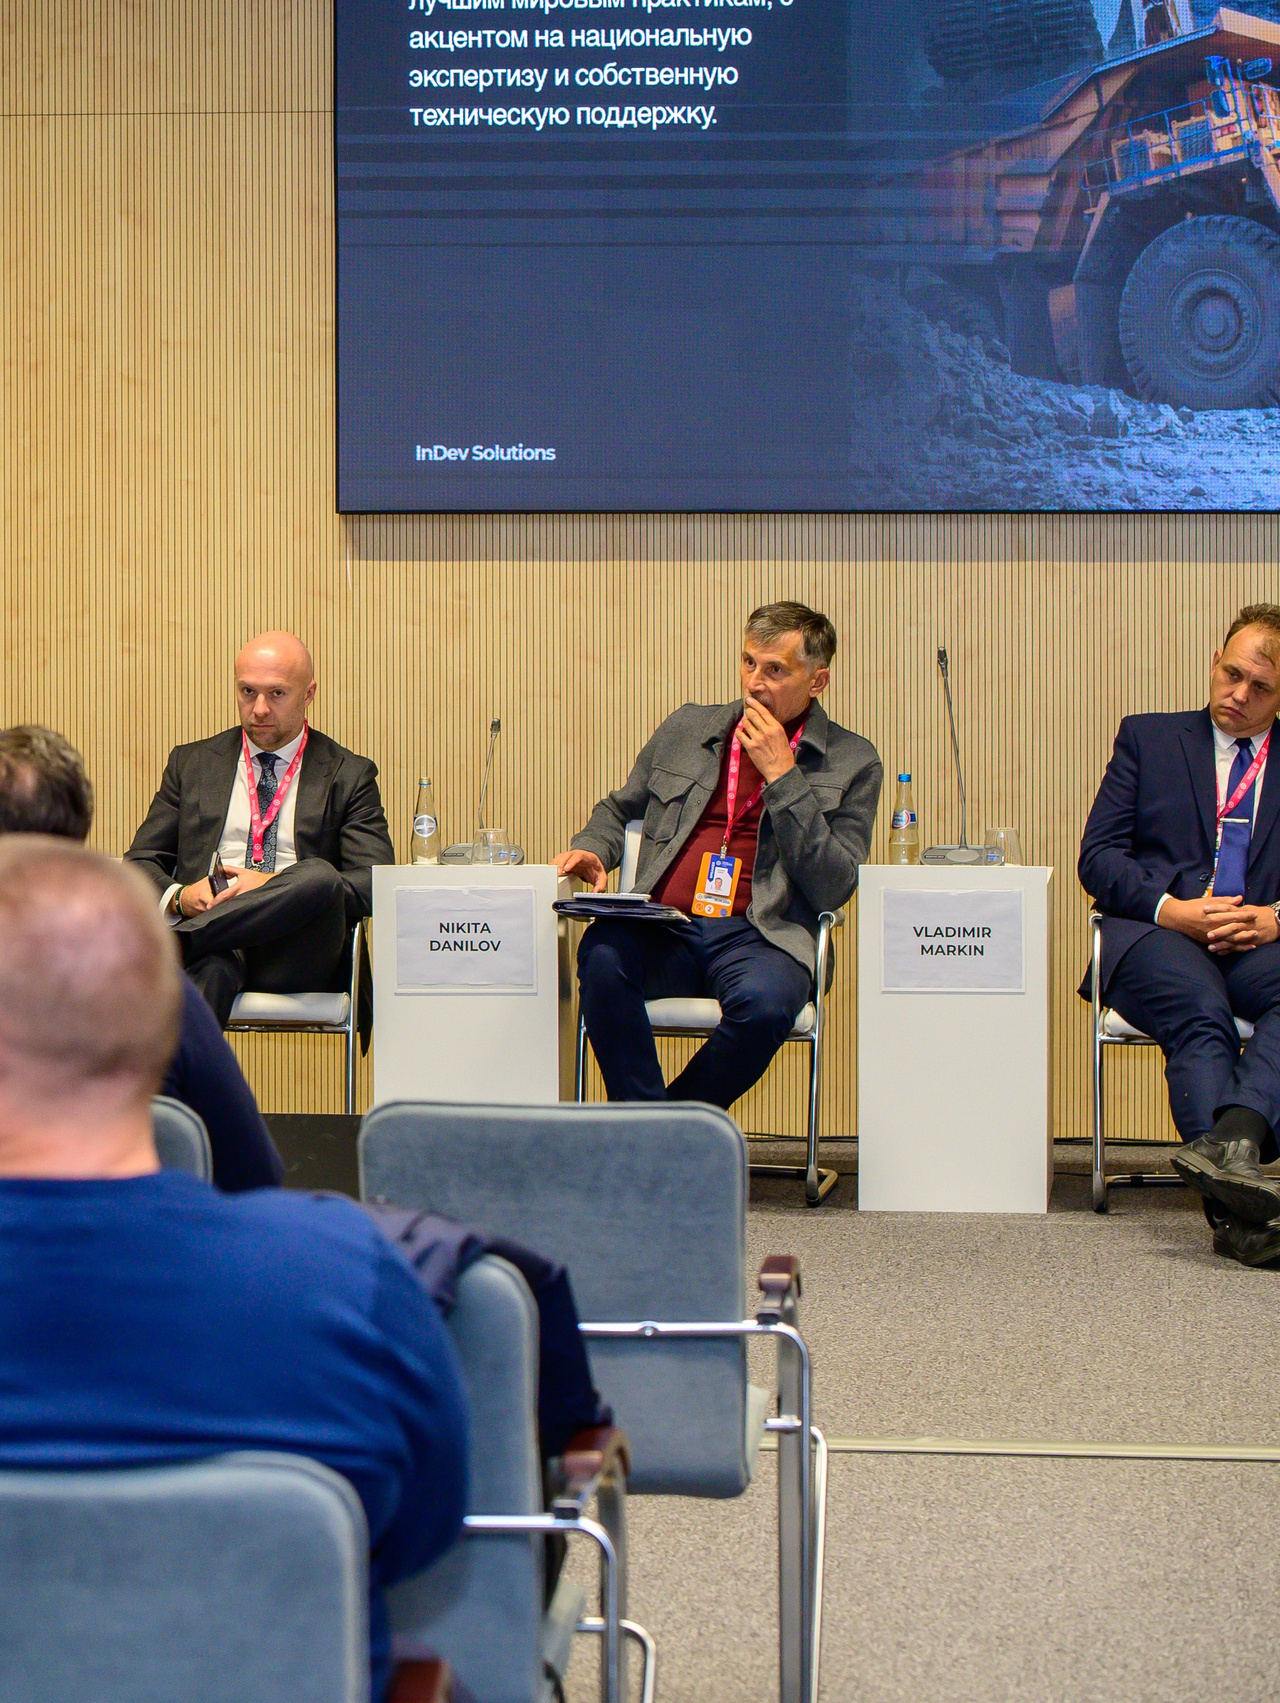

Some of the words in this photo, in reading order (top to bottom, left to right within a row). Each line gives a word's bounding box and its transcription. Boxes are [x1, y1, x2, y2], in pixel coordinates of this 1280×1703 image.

[409, 29, 528, 52] акцентом
[534, 29, 566, 48] на
[571, 27, 753, 52] национальную
[408, 68, 549, 92] экспертизу
[554, 68, 569, 86] и
[574, 63, 739, 91] собственную
[409, 106, 571, 131] техническую
[576, 105, 718, 130] поддержку.
[415, 444, 469, 461] InDev
[472, 442, 556, 461] Solutions
[438, 922, 492, 934] NIKITA
[912, 926, 992, 939] VLADIMIR
[429, 940, 502, 952] DANILOV
[920, 944, 984, 957] MARKIN
